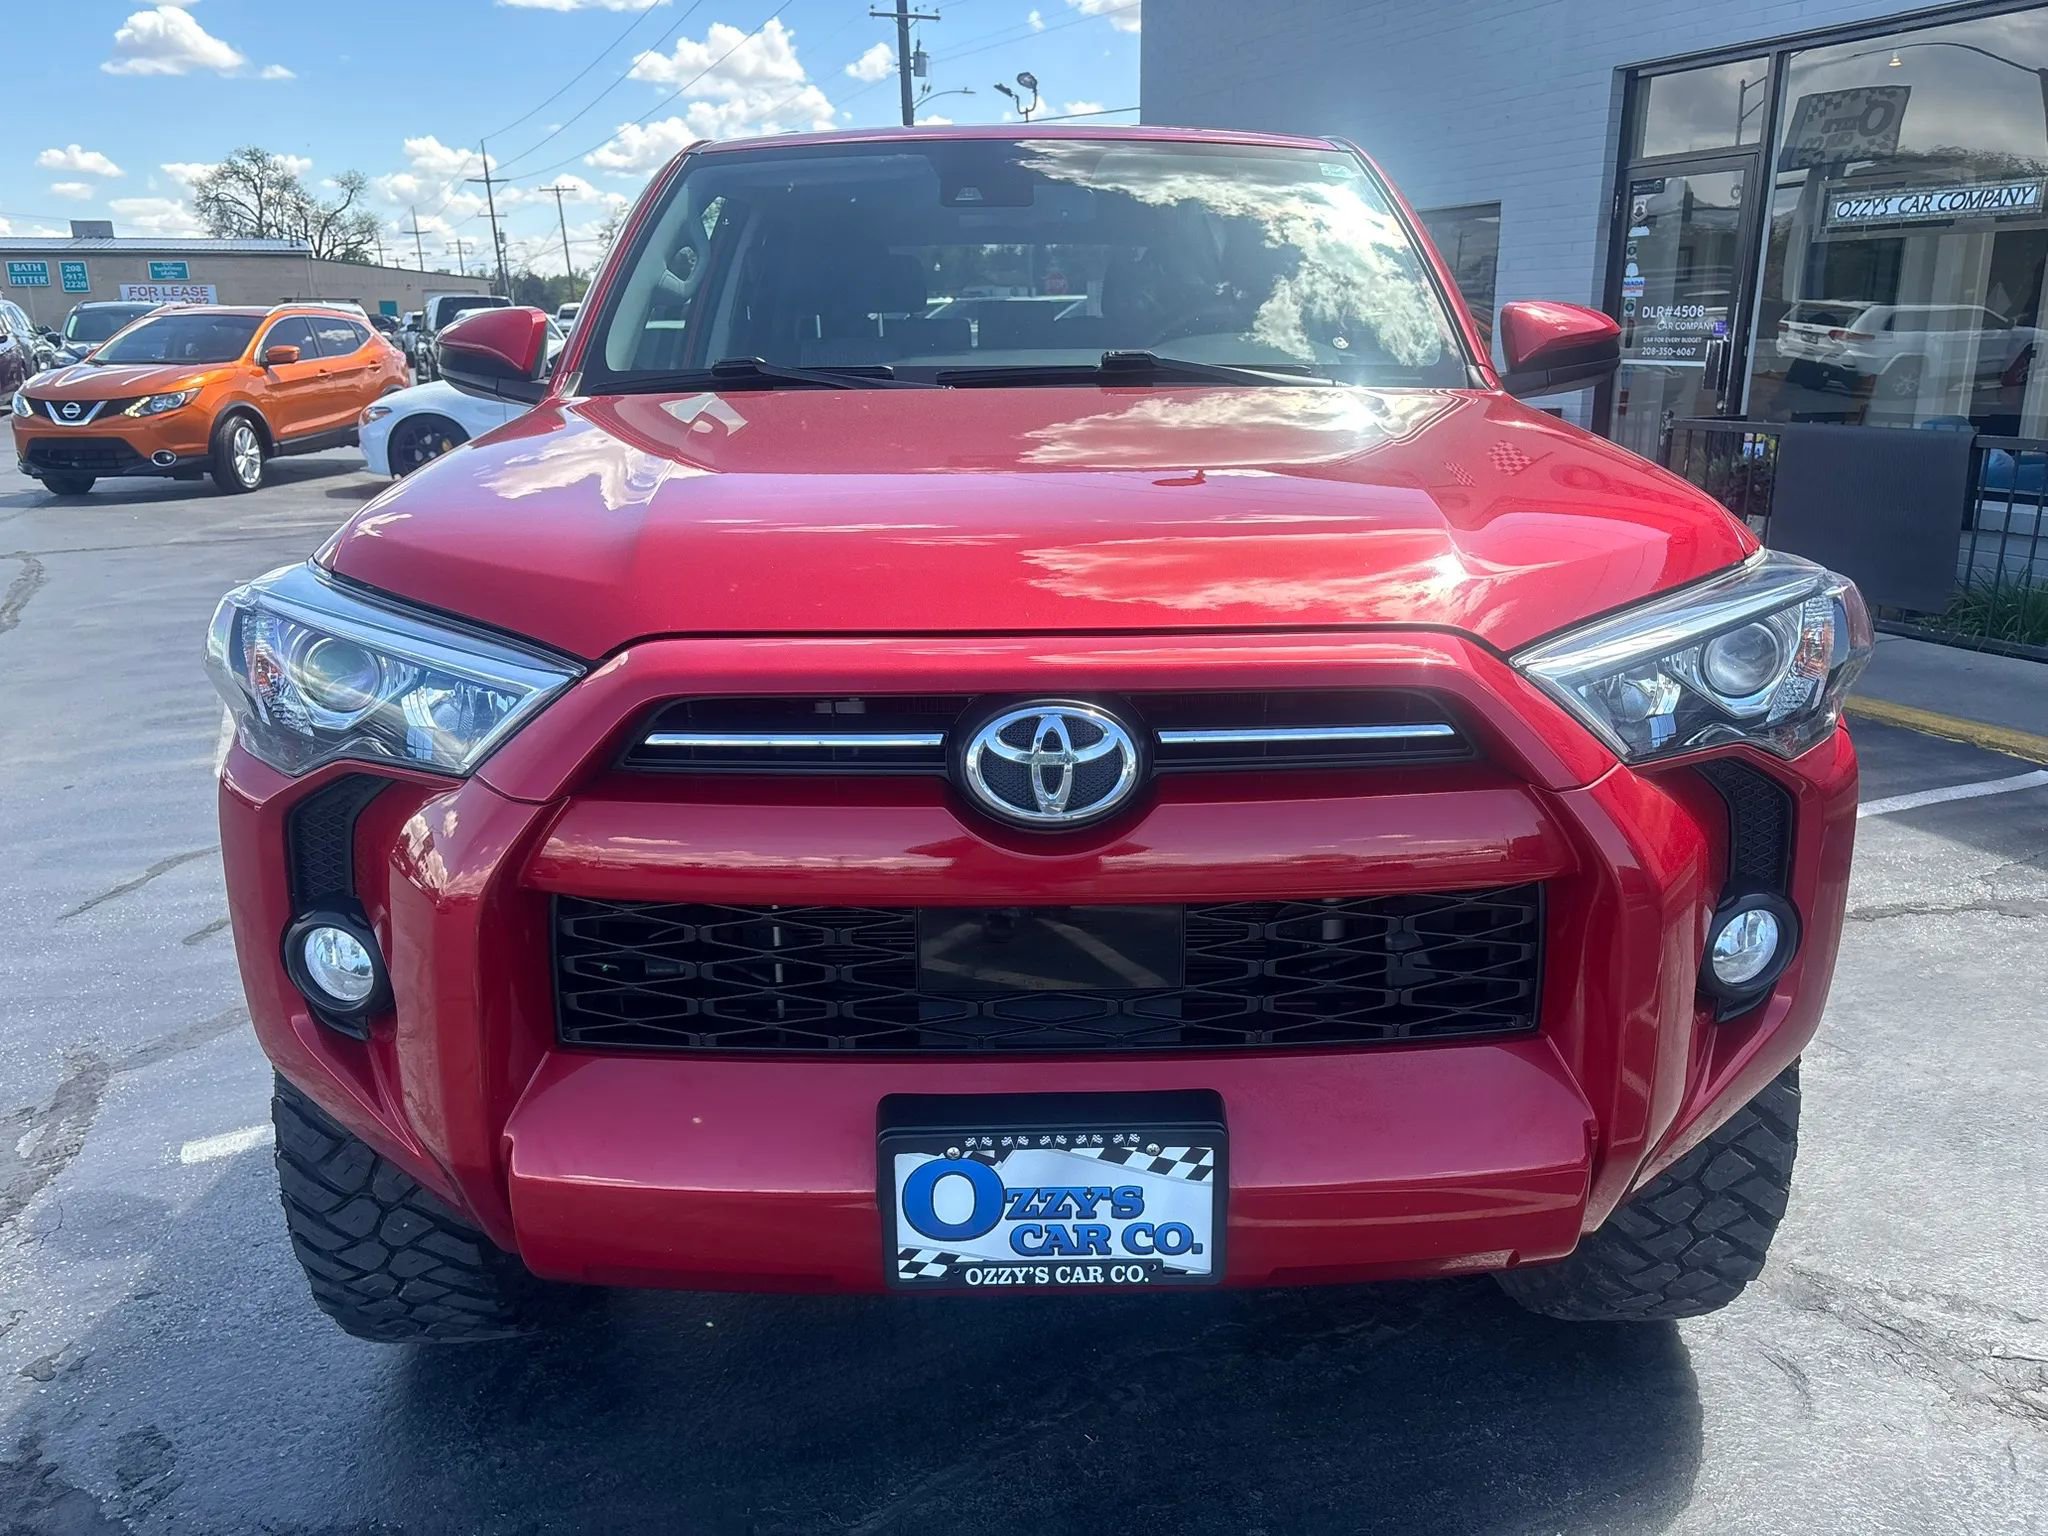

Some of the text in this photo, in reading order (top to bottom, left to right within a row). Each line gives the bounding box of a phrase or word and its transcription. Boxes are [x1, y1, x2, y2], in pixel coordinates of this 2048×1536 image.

[1837, 186, 2035, 218] OZZY'S CAR COMPANY
[13, 264, 41, 272] BATH
[12, 276, 47, 284] FITTER
[65, 281, 87, 289] 2220
[128, 286, 209, 297] FOR LEASE
[1642, 305, 1705, 318] DLR#4508
[1657, 322, 1673, 331] CAR
[1675, 321, 1715, 331] COMPANY
[1641, 347, 1696, 356] 208-350-6067
[901, 1158, 1145, 1242] OZZY'S
[1009, 1222, 1204, 1256] CAR CO.
[965, 1264, 1149, 1286] OZZY'S CAR CO.
